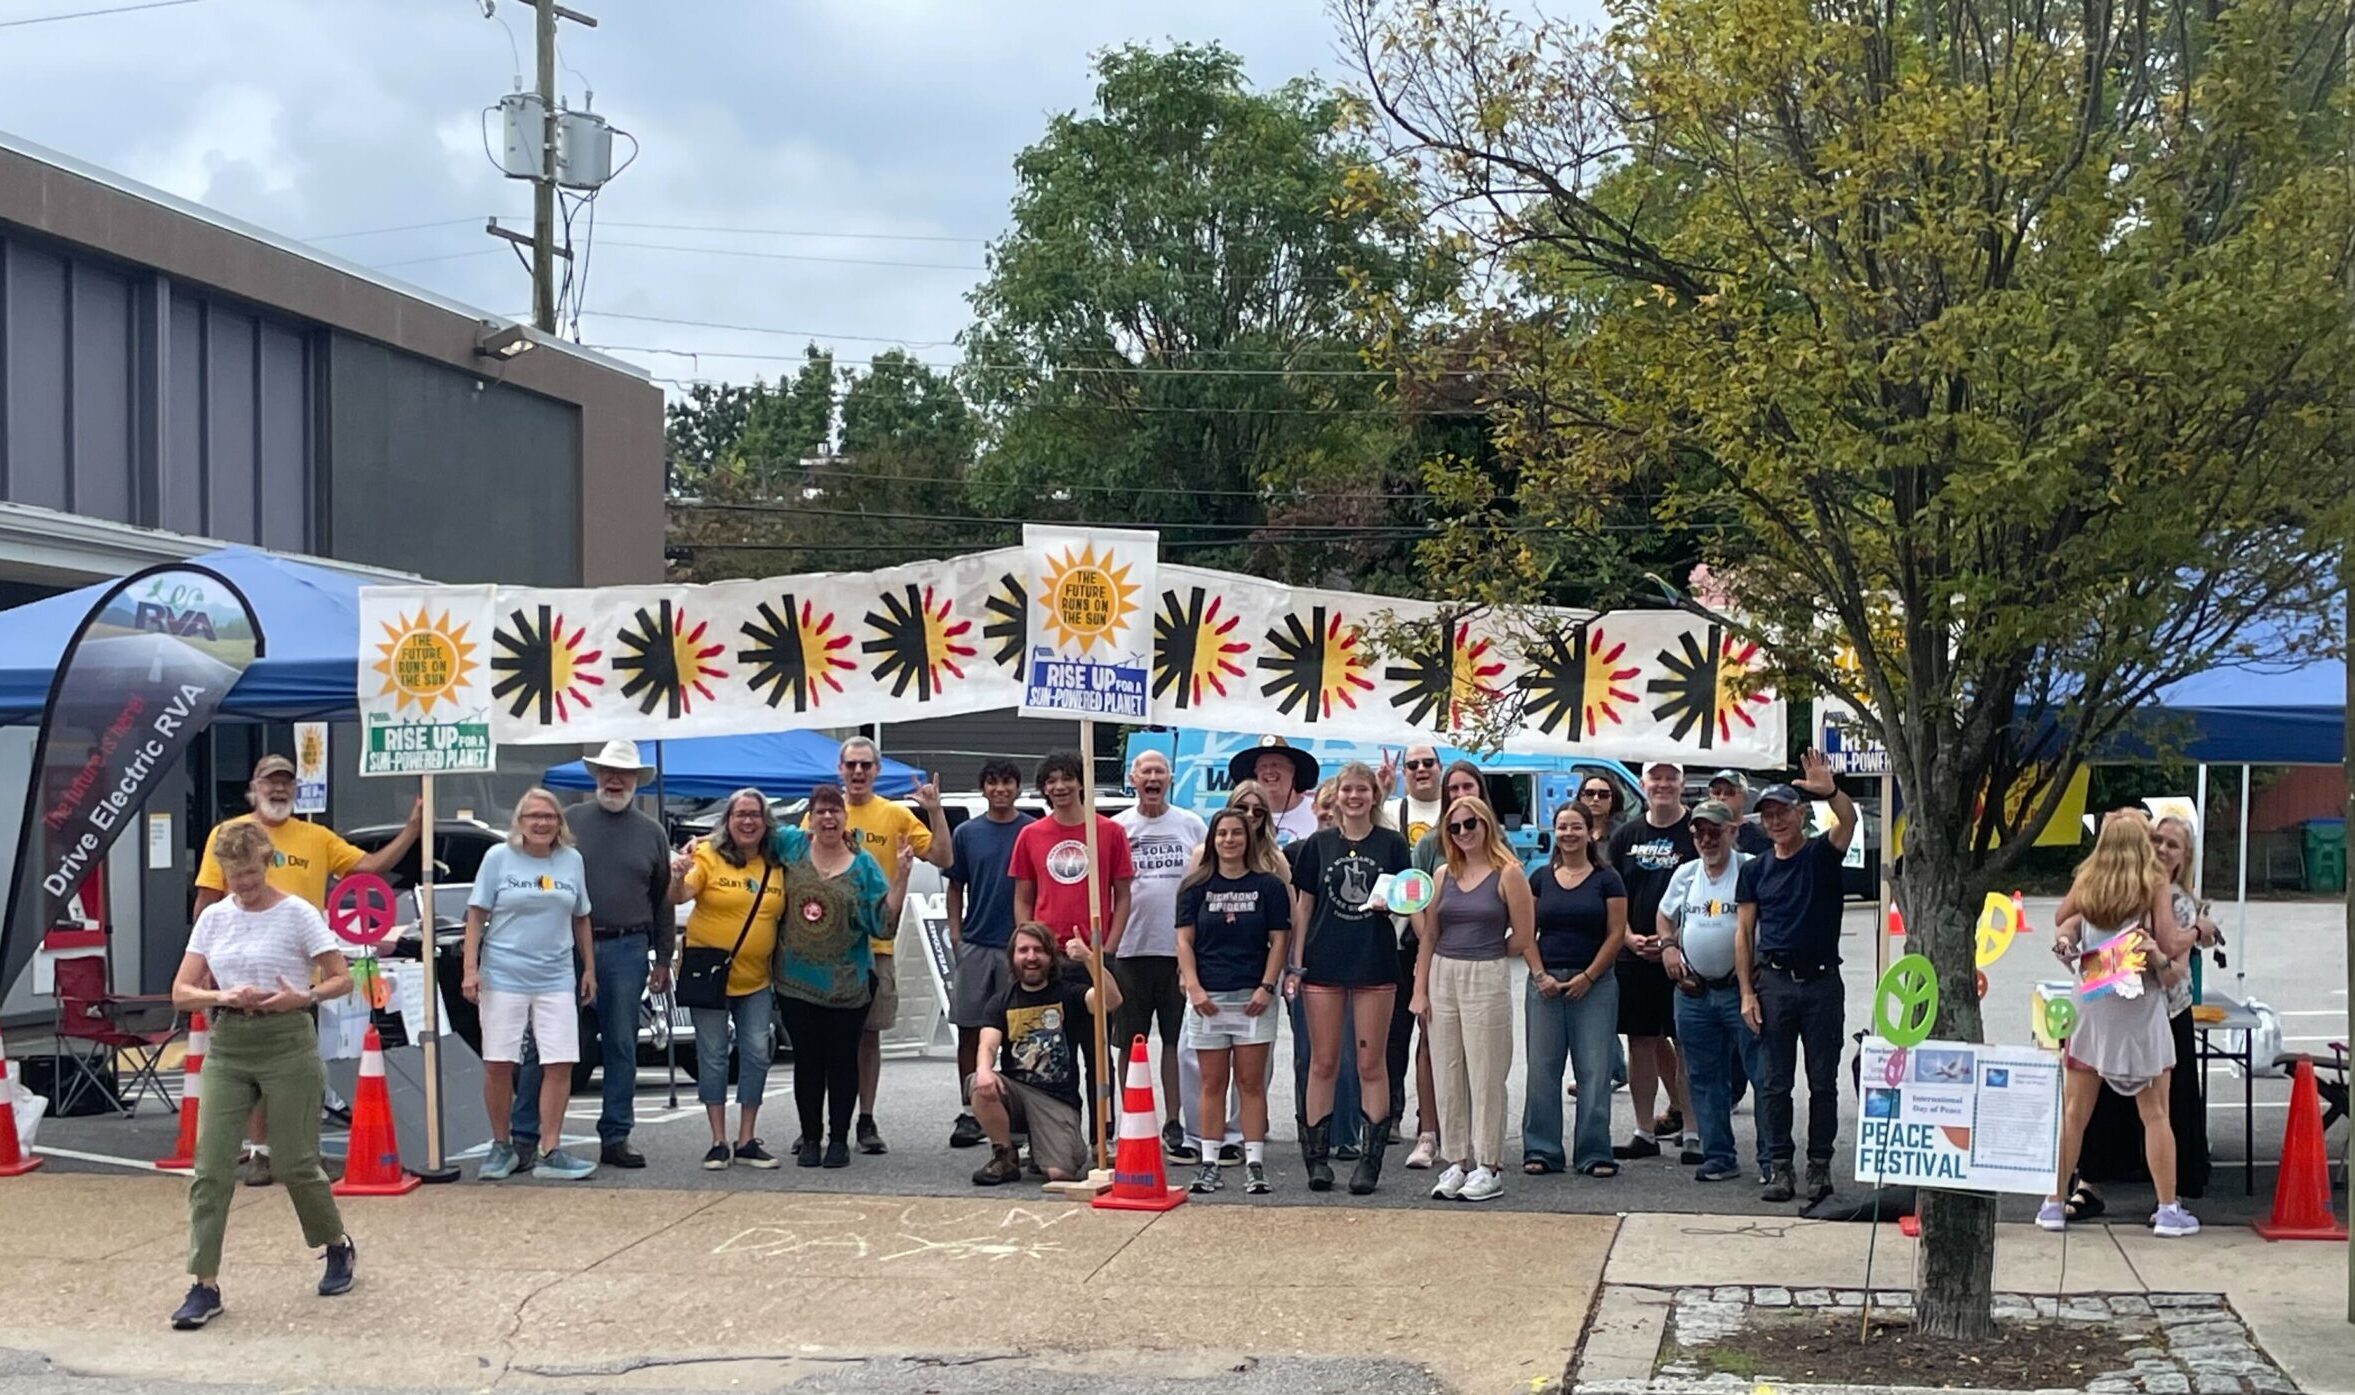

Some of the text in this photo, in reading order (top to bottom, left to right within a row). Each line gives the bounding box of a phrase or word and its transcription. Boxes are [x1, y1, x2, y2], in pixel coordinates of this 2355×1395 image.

[1076, 571, 1096, 584] THE
[1066, 584, 1105, 598] FUTURE
[1062, 598, 1108, 612] RUNS ON
[135, 601, 217, 641] RVA
[1063, 612, 1106, 625] THE SUN
[412, 633, 432, 646] THE
[402, 647, 442, 660] FUTURE
[399, 660, 447, 673] RUNS ON
[400, 674, 446, 686] THE SUN
[1046, 664, 1143, 693] RISE UP FOR A
[1028, 687, 1143, 716] SUN-POWERED PLANET
[384, 726, 486, 751] RISE UP FOR A
[369, 749, 486, 772] SUN-POWERED PLANET
[43, 684, 206, 897] Drive Electric RVA
[866, 832, 888, 846] Day
[1142, 845, 1183, 856] SOLAR
[288, 855, 309, 869] Day
[506, 875, 533, 889] Sun
[719, 877, 741, 888] Sun
[1206, 891, 1259, 901] RICHMOND
[1208, 901, 1256, 912] SPIDERS
[1722, 902, 1738, 914] Da
[1861, 1122, 1934, 1149] PEACE
[1859, 1148, 1967, 1180] FESTIVAL
